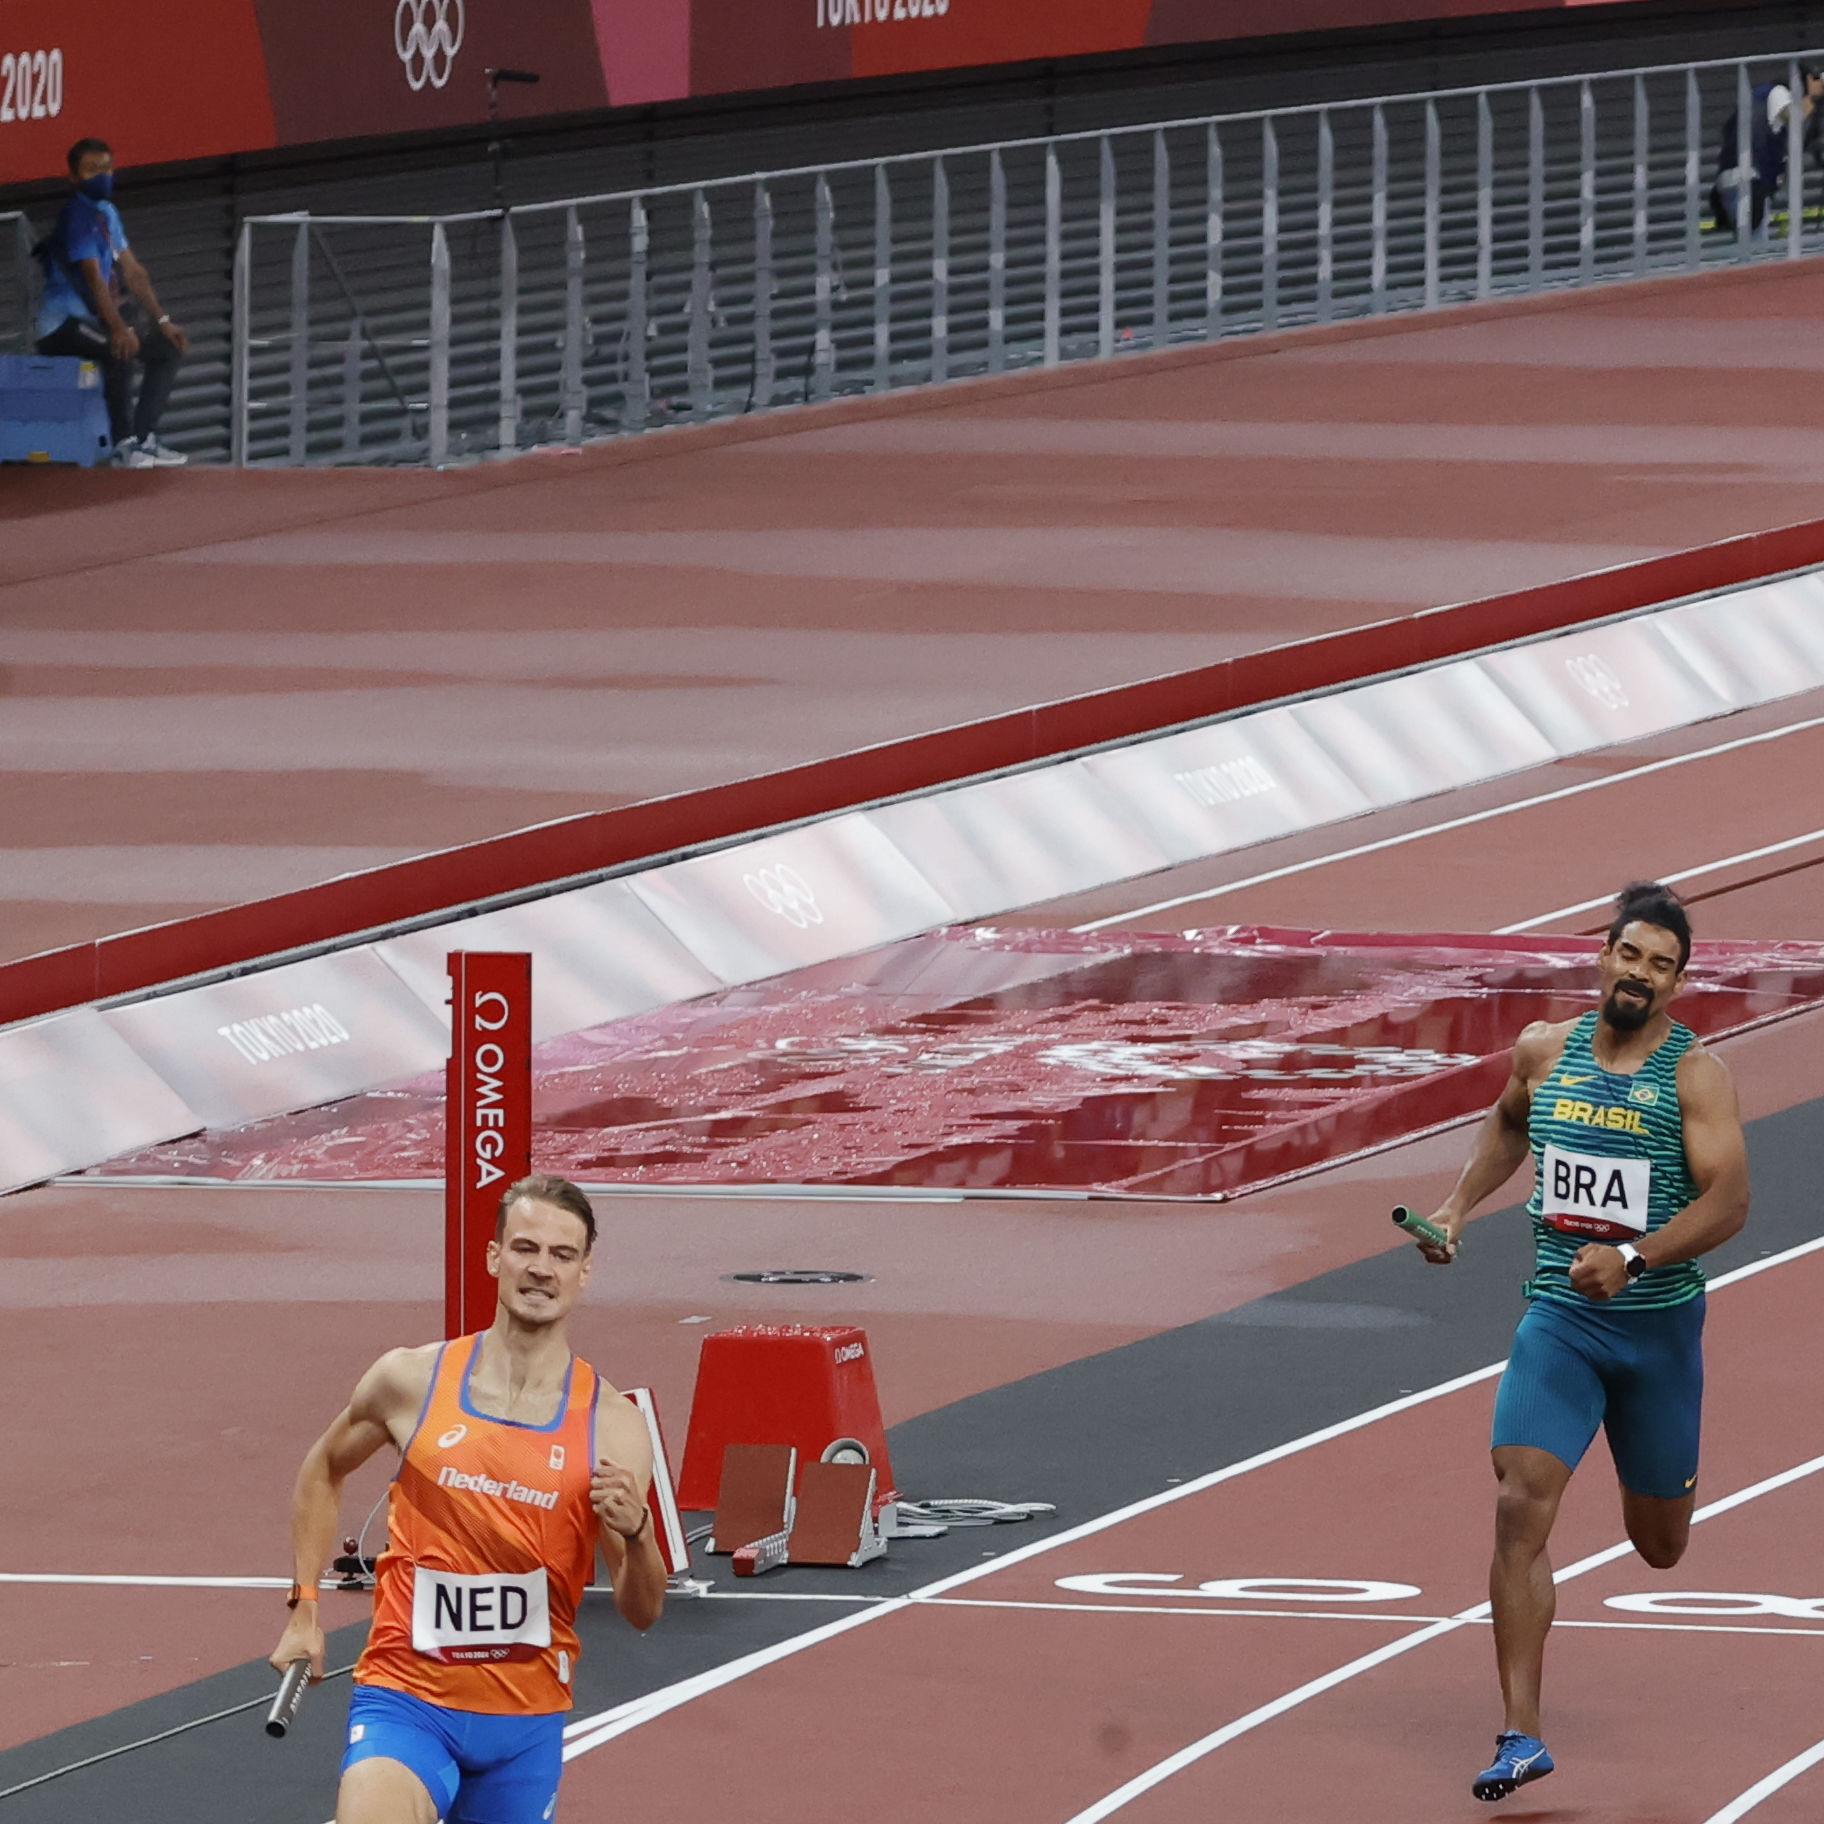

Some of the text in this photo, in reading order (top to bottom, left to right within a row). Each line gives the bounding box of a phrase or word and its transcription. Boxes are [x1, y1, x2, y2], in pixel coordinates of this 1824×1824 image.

[0, 47, 64, 123] 2020
[474, 1042, 506, 1190] OMEGA
[1553, 1098, 1651, 1135] BRASIL
[1554, 1158, 1629, 1210] BRA
[434, 1583, 528, 1632] NED
[1055, 1573, 1421, 1602] 9
